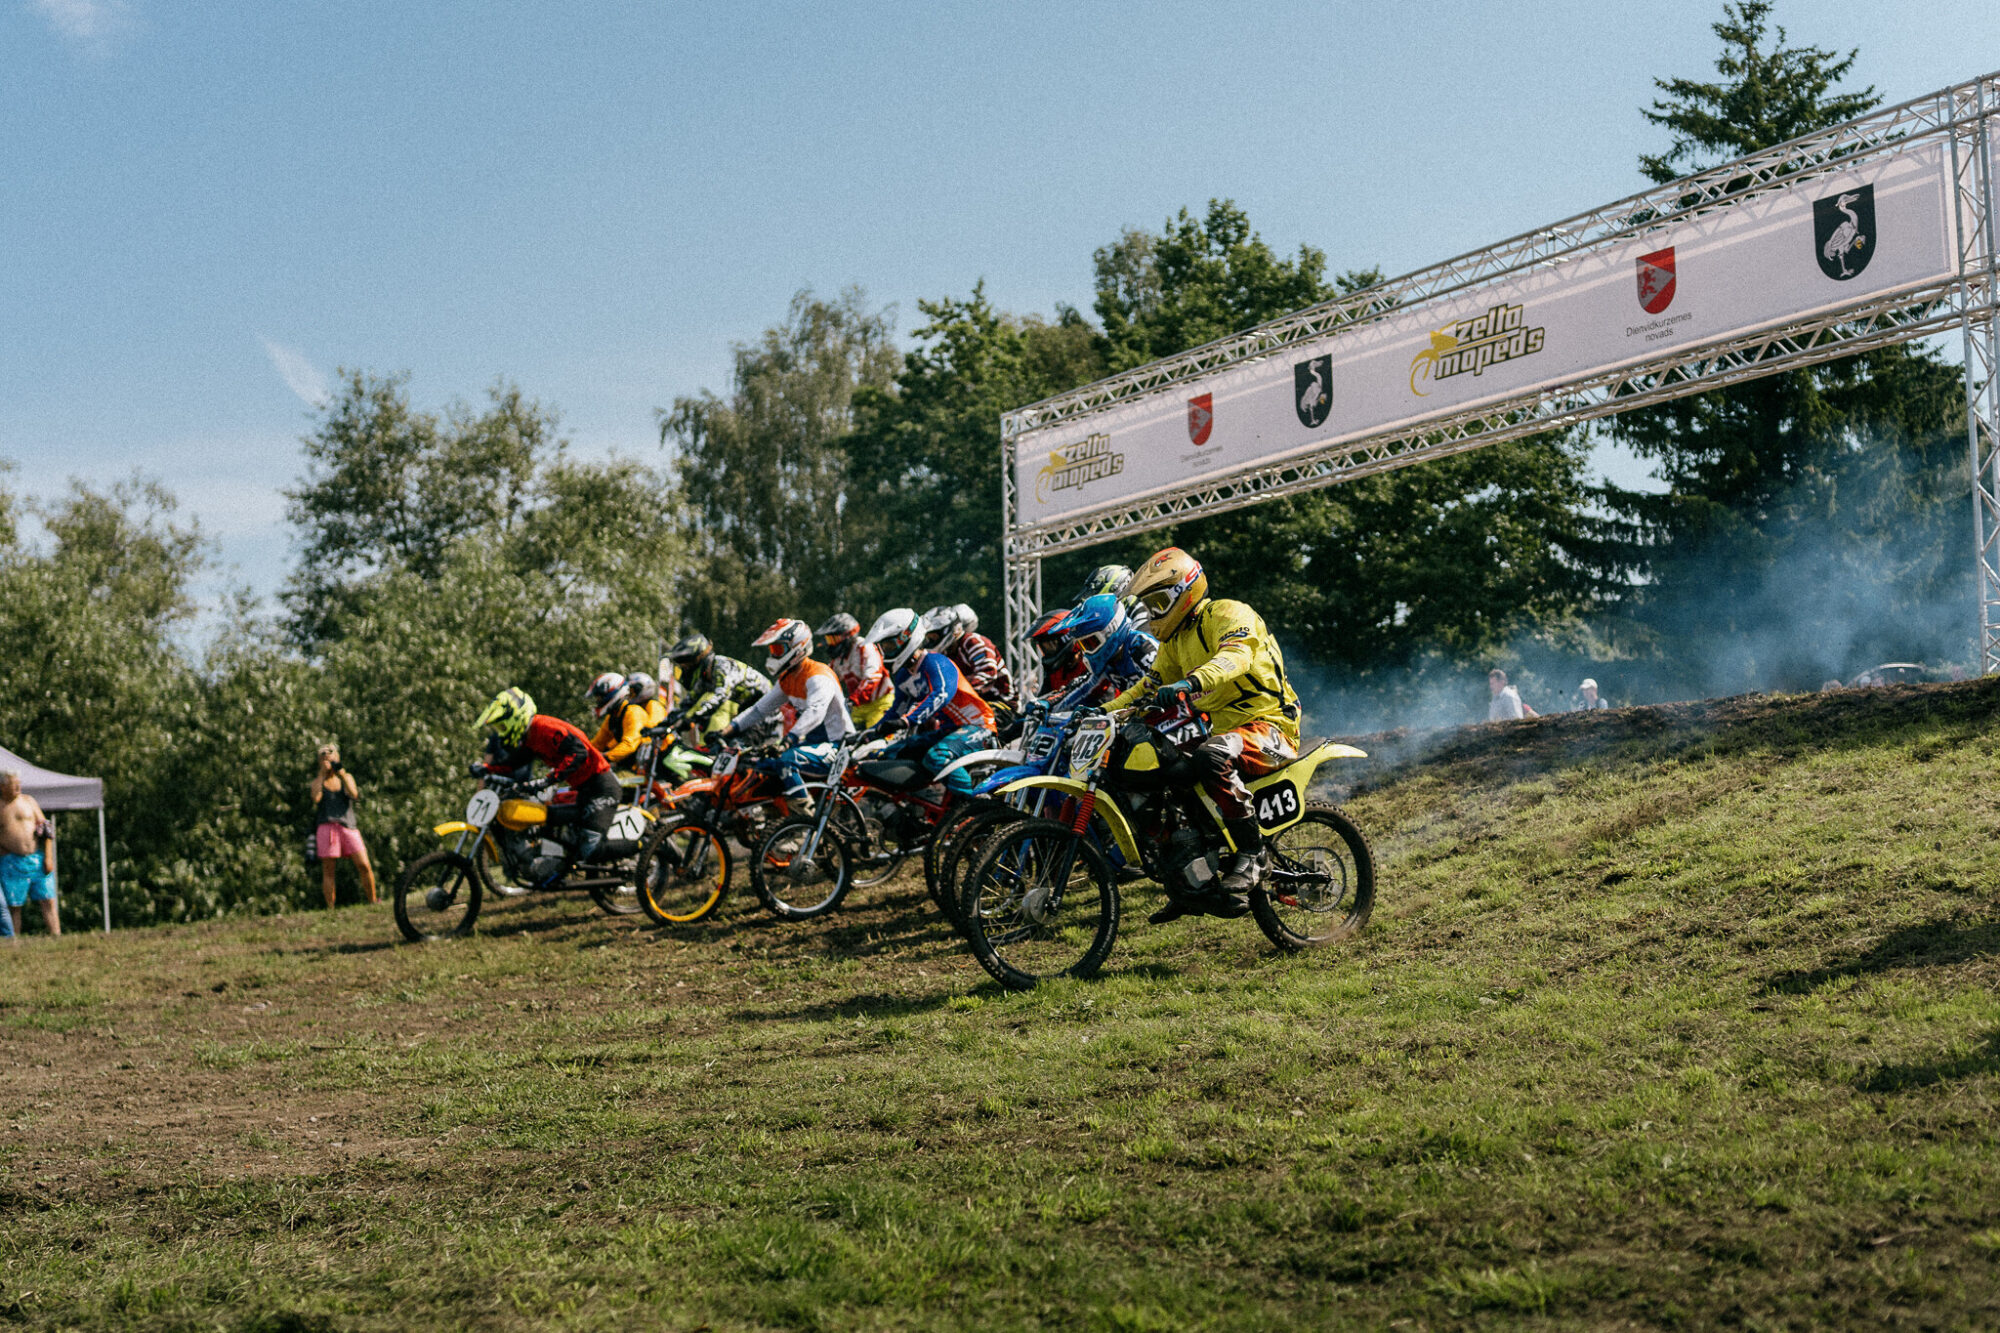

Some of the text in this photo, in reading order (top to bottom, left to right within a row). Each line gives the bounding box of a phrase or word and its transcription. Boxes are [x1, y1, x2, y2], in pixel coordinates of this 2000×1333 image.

[1626, 312, 1692, 337] Dienvidkurzemes
[1645, 328, 1674, 341] novads
[1073, 734, 1104, 760] 413
[1261, 746, 1289, 762] SCOTT
[472, 799, 491, 822] 71
[1259, 789, 1297, 821] 413
[609, 815, 640, 840] 71
